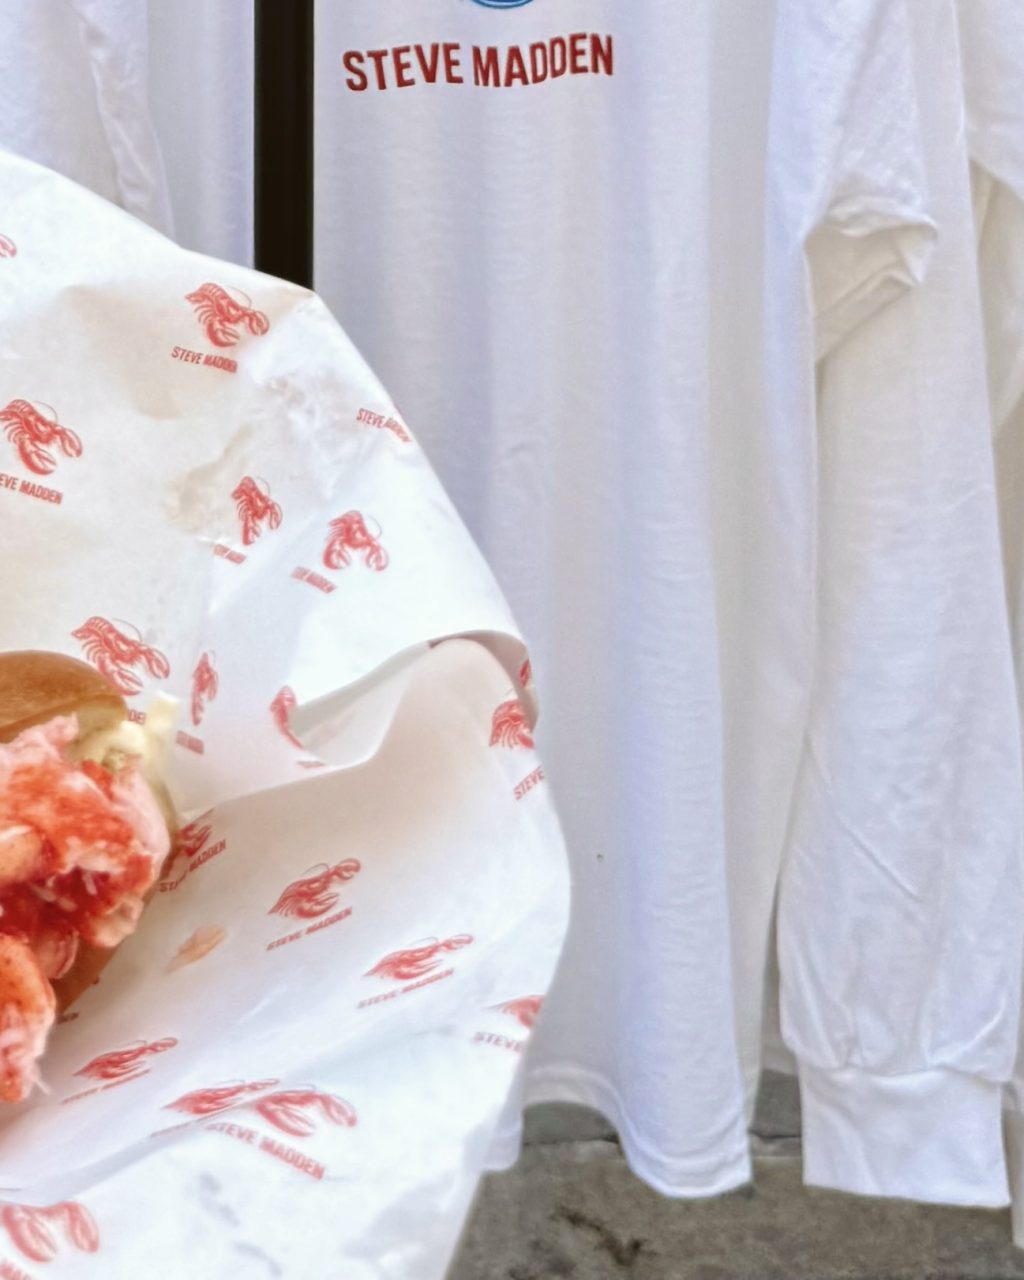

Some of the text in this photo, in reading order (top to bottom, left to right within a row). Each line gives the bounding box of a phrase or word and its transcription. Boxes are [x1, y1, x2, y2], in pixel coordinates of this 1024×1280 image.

[342, 32, 614, 91] STEVE MADDEN
[171, 346, 203, 364] STEVE
[356, 408, 385, 428] STEVE
[19, 480, 63, 505] MADDEN
[513, 766, 545, 800] STEVE
[259, 1136, 326, 1181] MADDEN
